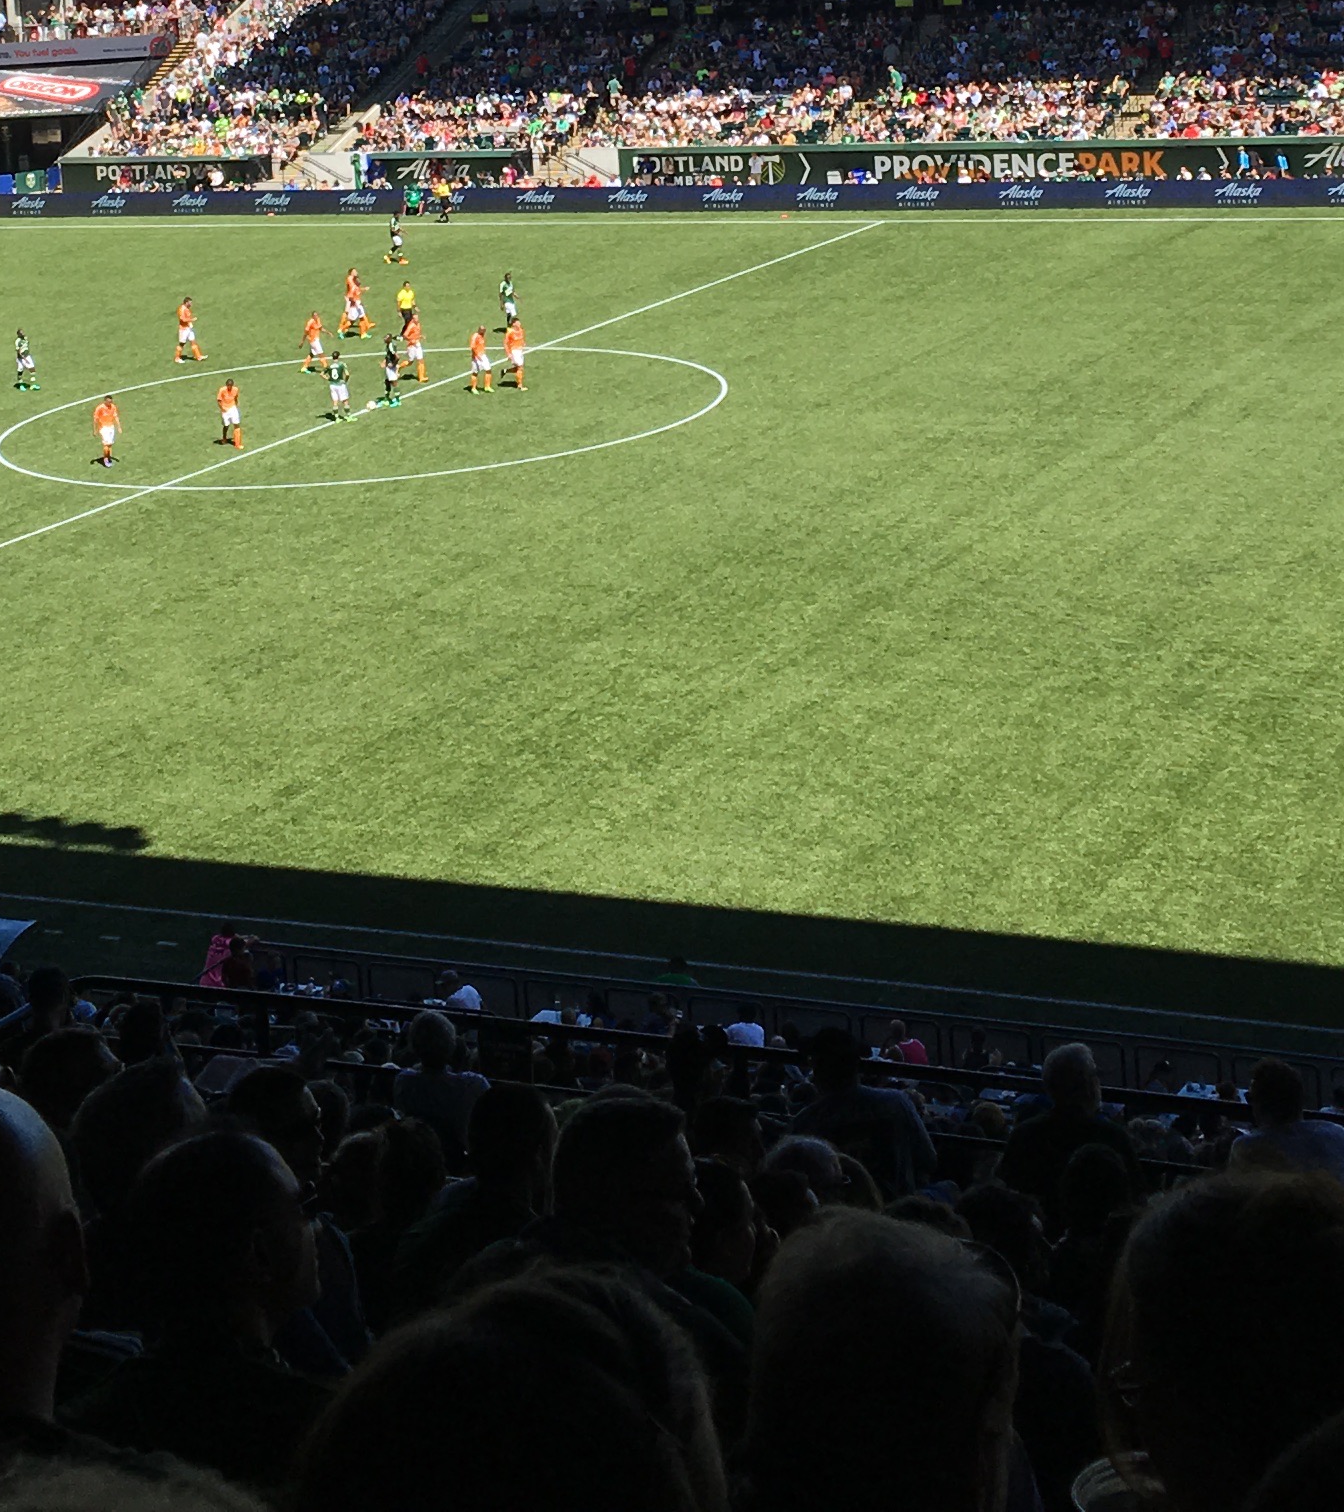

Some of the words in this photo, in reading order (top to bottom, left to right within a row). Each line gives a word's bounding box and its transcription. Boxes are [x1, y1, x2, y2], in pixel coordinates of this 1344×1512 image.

[14, 49, 32, 58] You
[33, 47, 50, 57] fuel
[9, 79, 84, 98] OREGON
[516, 190, 555, 203] Alaska
[608, 190, 648, 203] Alaska
[703, 187, 743, 202] Alaska
[797, 187, 839, 201] Alaska
[896, 186, 939, 200] Alaska
[999, 185, 1043, 199] Alaska
[1105, 184, 1151, 198] Alaska
[1215, 182, 1262, 197] Alaska
[12, 196, 46, 209] Alaska
[91, 196, 126, 207] Alaska
[172, 193, 207, 207] Alaska
[255, 193, 290, 206] Alaska
[339, 193, 376, 205] Alaska
